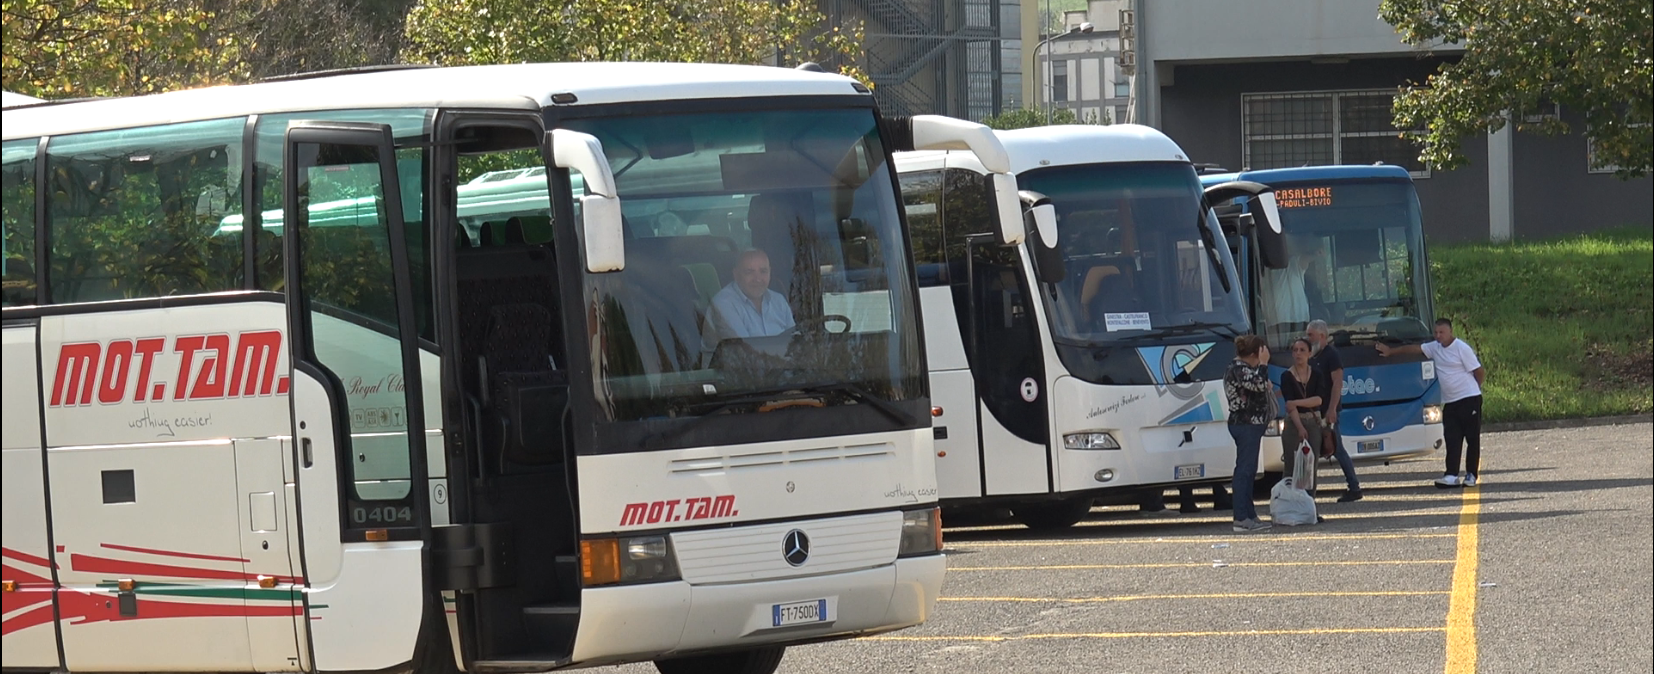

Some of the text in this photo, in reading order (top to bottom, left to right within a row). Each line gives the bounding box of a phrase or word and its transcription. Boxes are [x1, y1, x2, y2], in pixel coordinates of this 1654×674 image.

[1275, 187, 1331, 200] CASALBORE
[347, 373, 405, 399] Royal Cla
[128, 407, 212, 437] nothing easier!
[355, 413, 363, 421] TV
[437, 489, 443, 499] 9
[619, 494, 740, 526] MOT.TAM.
